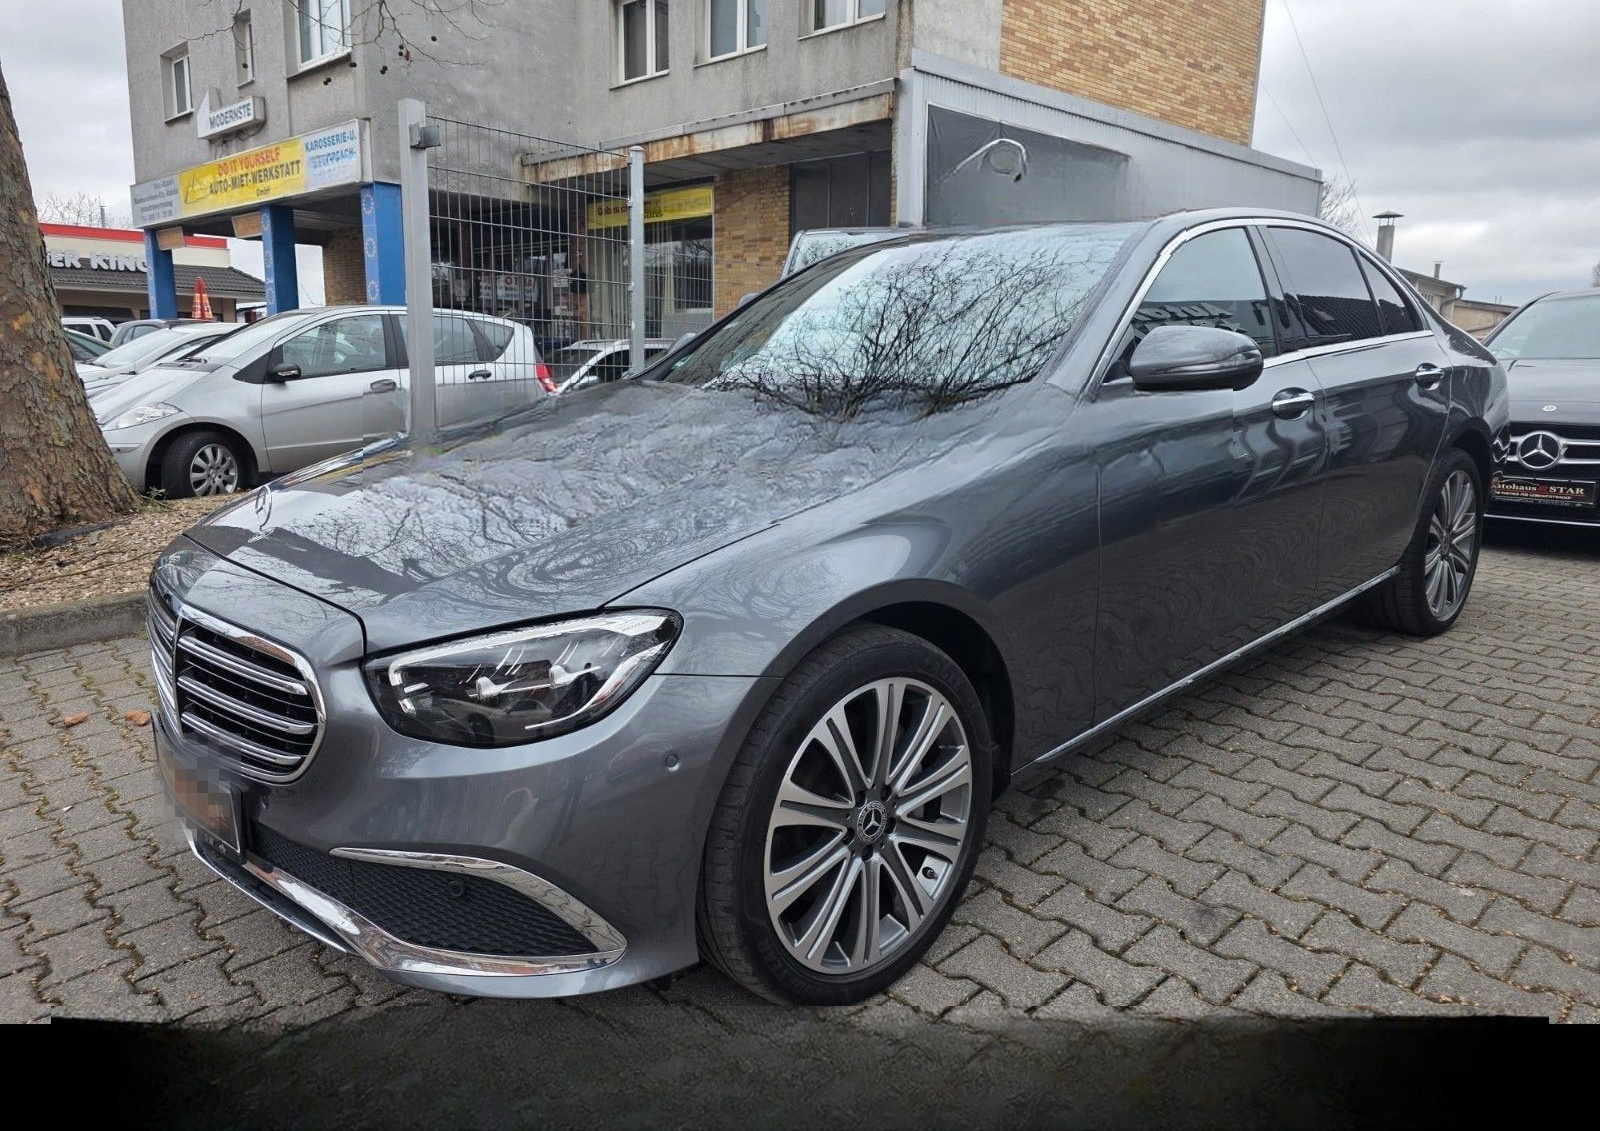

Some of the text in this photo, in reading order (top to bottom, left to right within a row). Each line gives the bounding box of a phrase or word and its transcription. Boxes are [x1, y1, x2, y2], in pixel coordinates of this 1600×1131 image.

[209, 102, 251, 130] MODERNSTE
[217, 146, 280, 176] DO IT YOURSELF
[209, 159, 301, 195] AUTO-MIET-WERKSTATT
[1549, 485, 1585, 495] STAR
